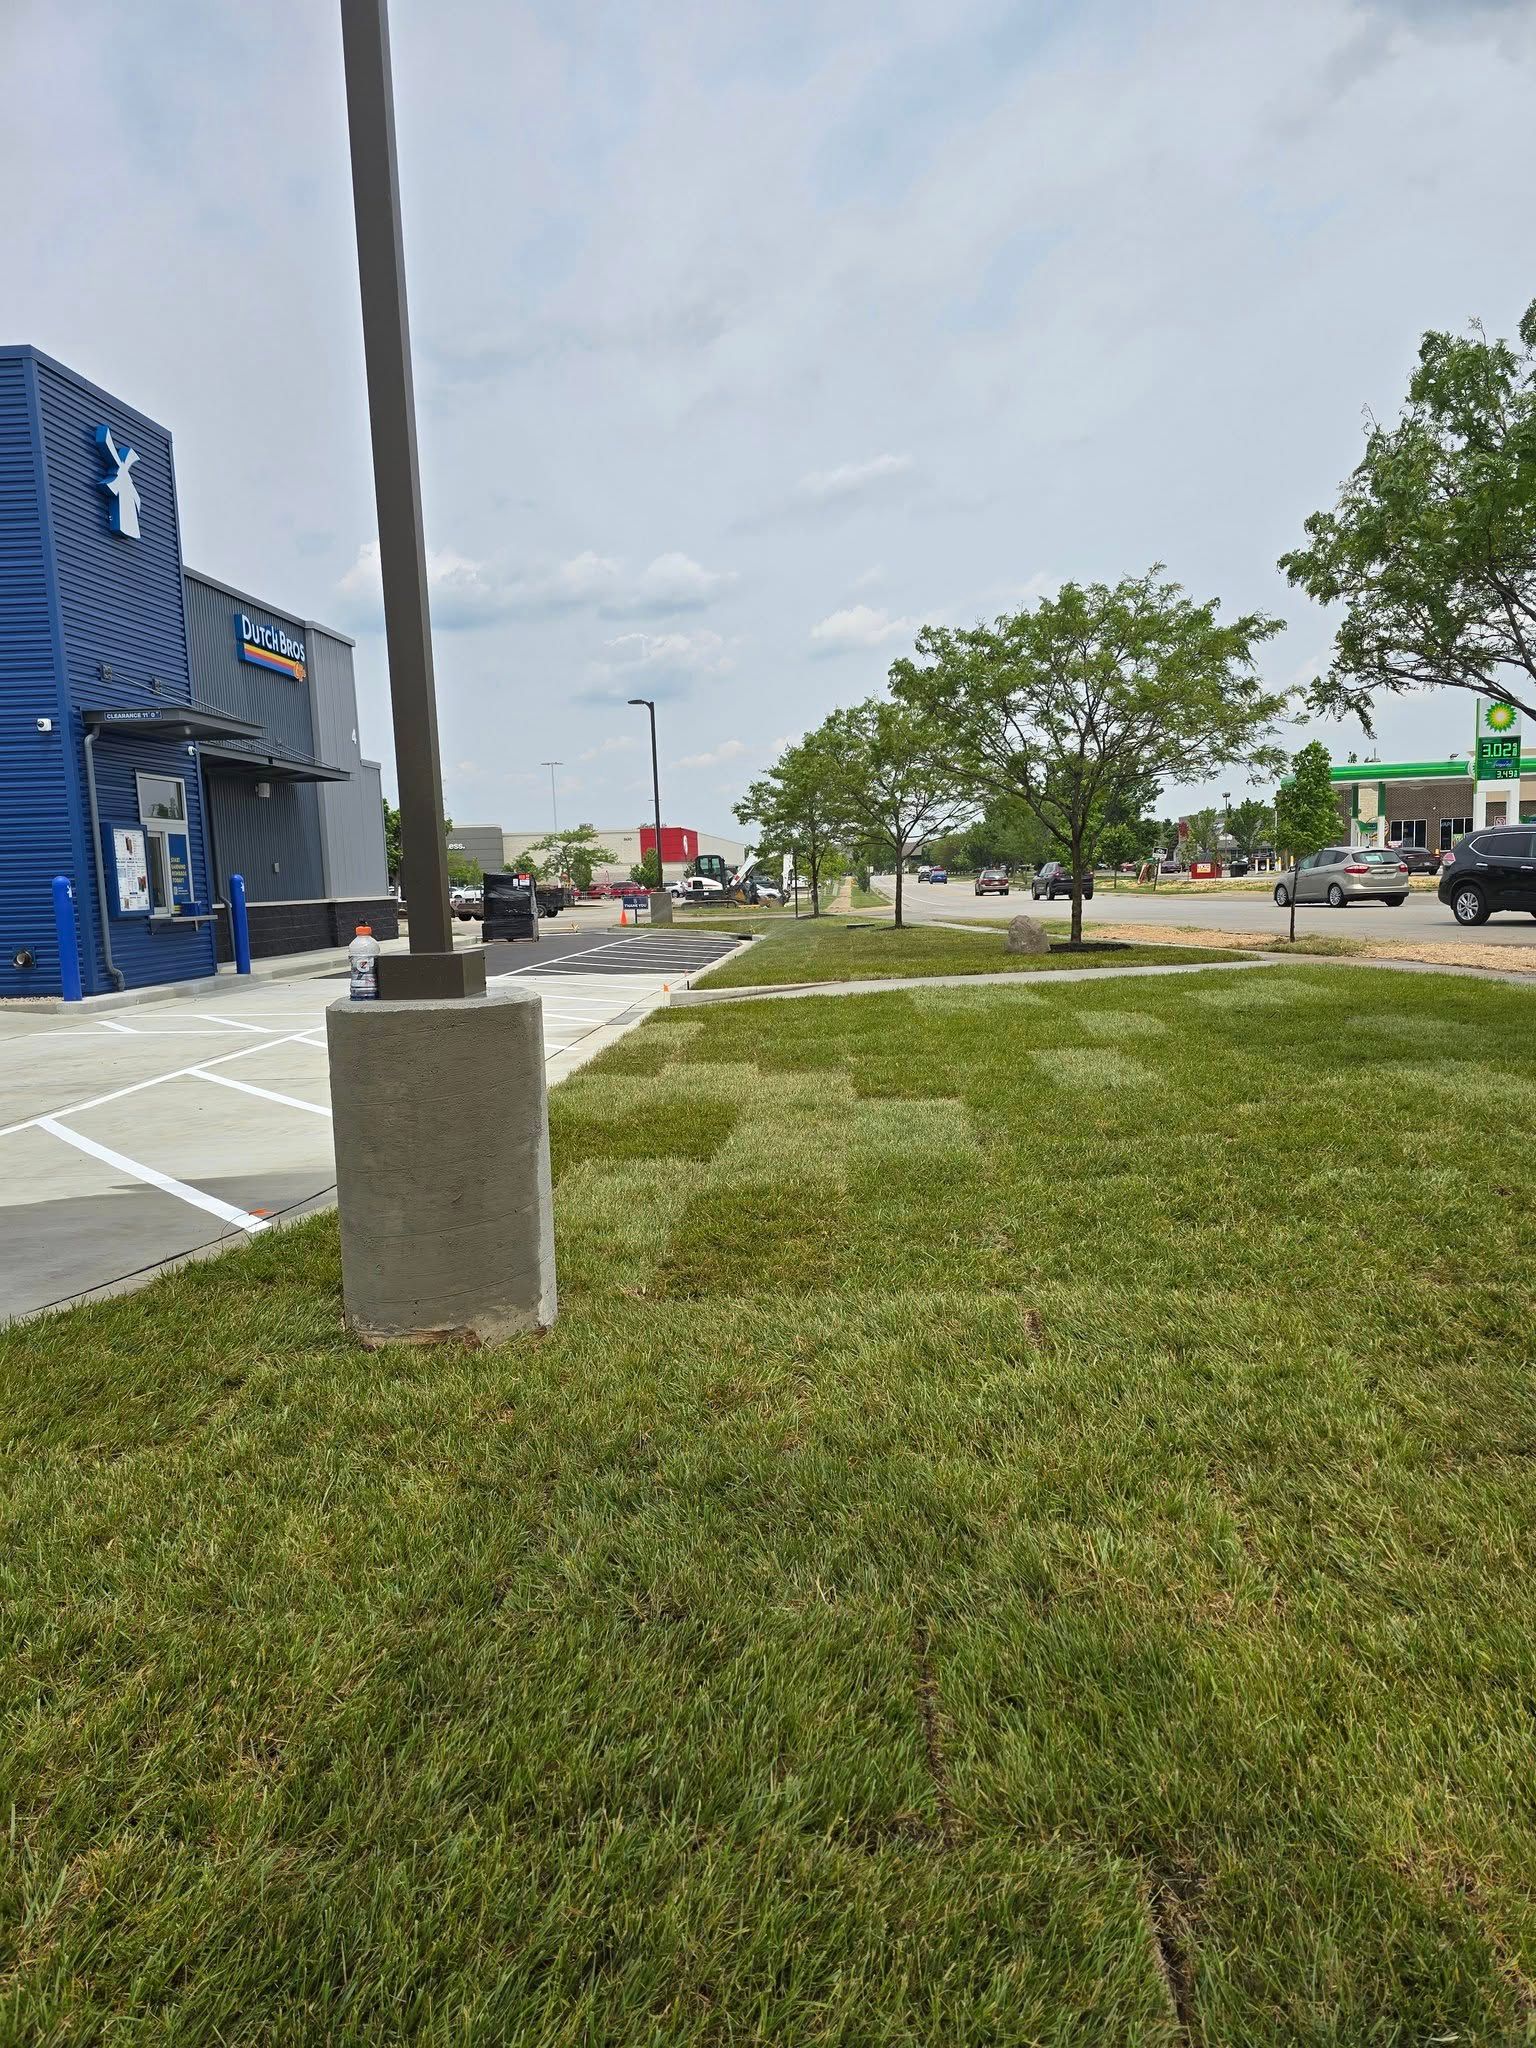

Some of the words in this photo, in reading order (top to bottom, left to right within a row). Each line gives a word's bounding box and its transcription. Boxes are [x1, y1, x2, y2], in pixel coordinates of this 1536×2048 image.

[241, 614, 280, 653] DUTCH
[279, 630, 306, 663] BROS
[351, 728, 357, 745] 4
